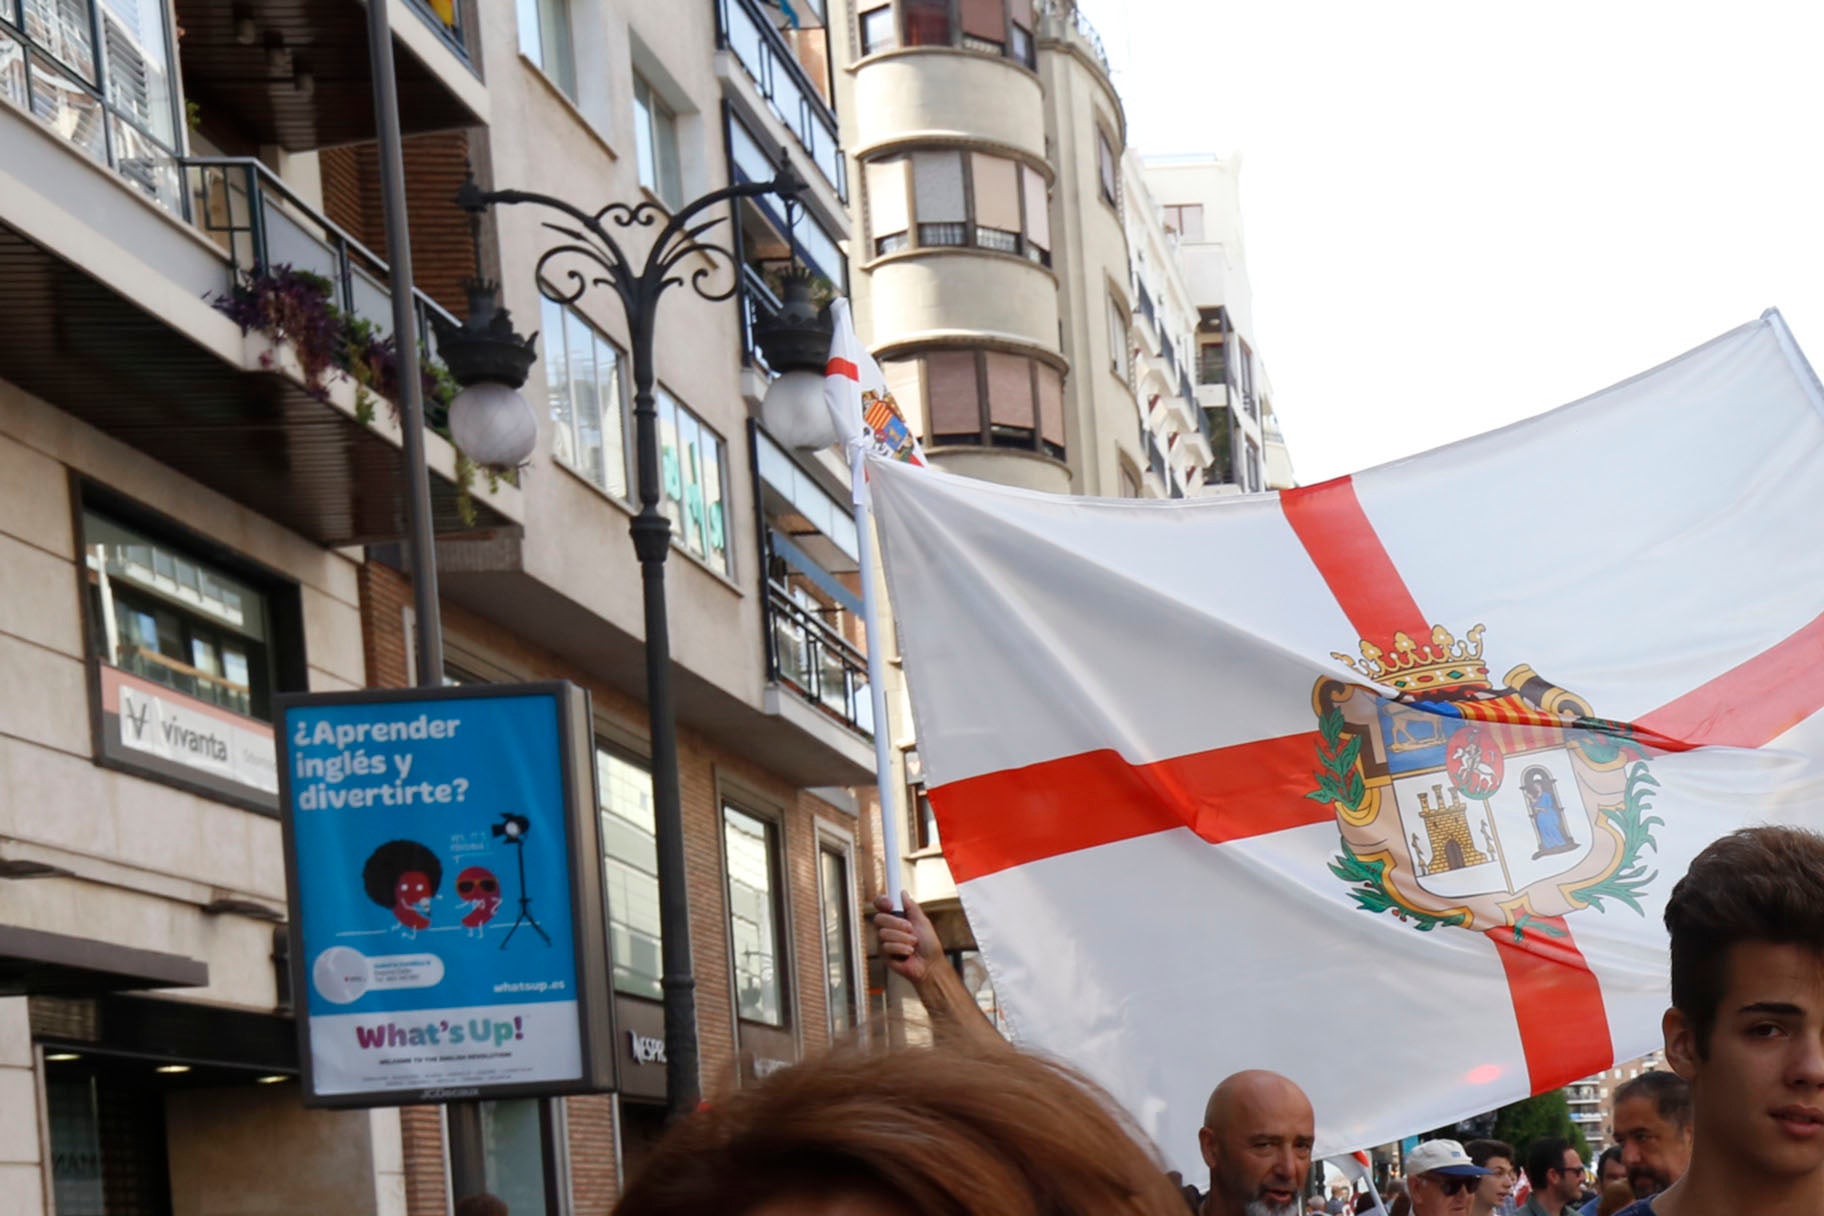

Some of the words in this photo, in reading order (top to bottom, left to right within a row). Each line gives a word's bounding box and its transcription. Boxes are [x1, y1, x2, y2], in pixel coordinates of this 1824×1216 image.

[162, 716, 228, 761] vivanta
[294, 715, 461, 749] ¿Aprender
[296, 750, 387, 783] inglés
[394, 753, 413, 779] y
[299, 778, 470, 811] divertirte?
[494, 980, 565, 993] whatsup.es
[355, 1020, 465, 1049] What's
[468, 1015, 524, 1047] Up!
[630, 1029, 668, 1065] NESPR
